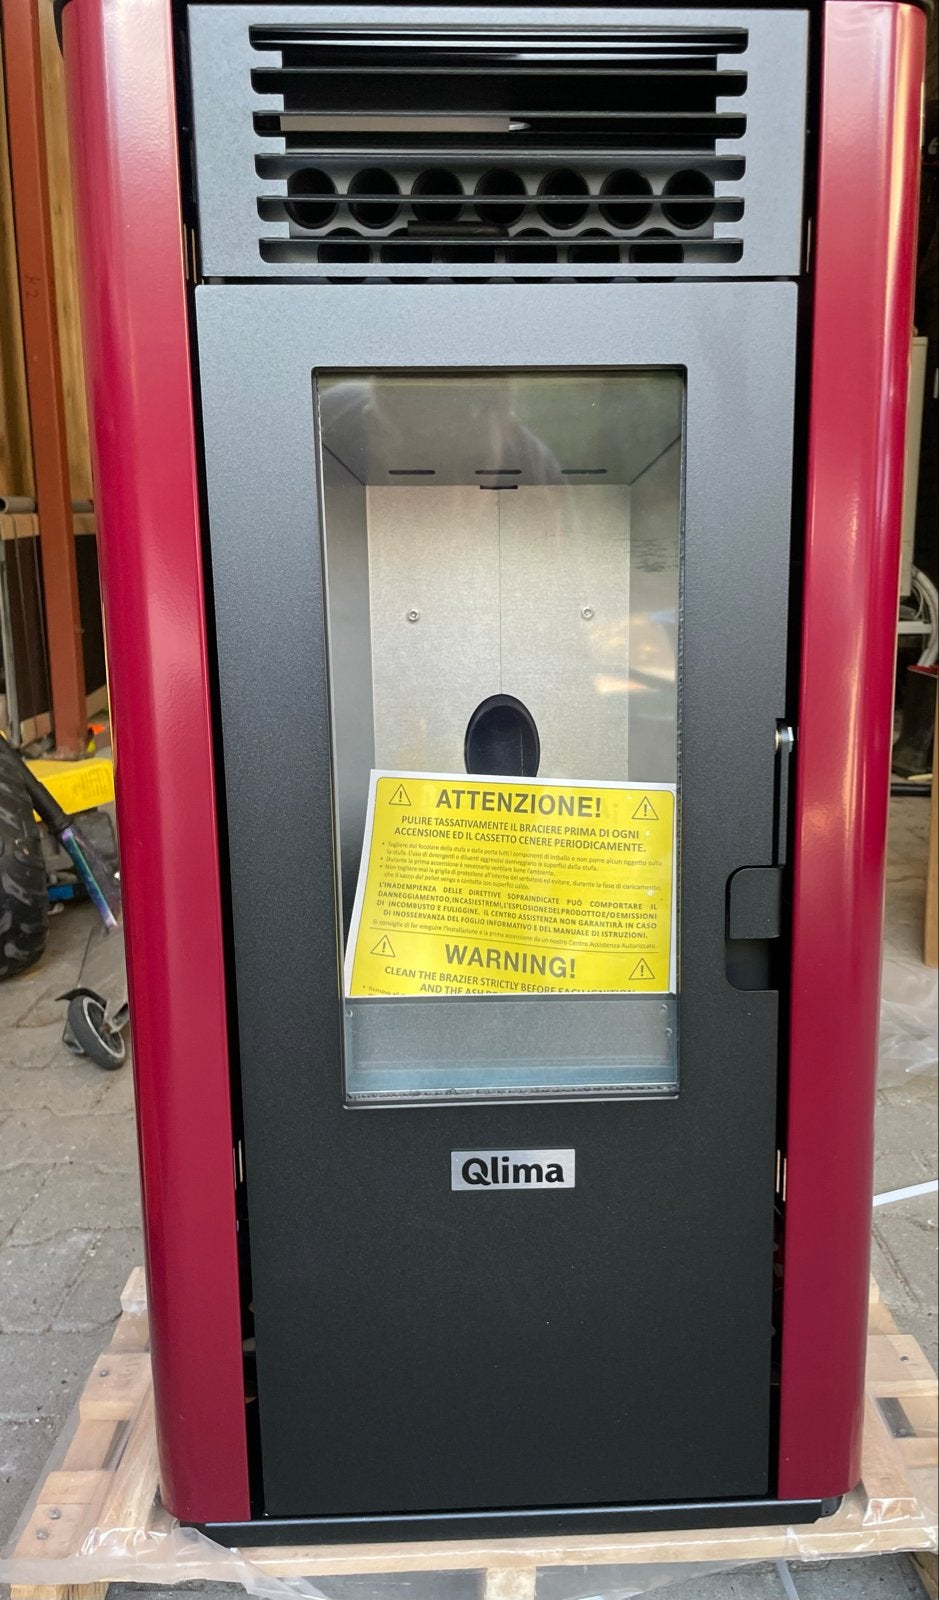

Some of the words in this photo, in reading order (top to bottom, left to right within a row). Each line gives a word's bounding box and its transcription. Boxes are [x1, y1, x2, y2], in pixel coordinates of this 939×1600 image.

[436, 788, 602, 818] ATTENZIONE!
[394, 827, 450, 839] ACCENSIONE
[452, 830, 464, 840] ED
[465, 831, 473, 841] IL
[474, 832, 517, 844] CASSETTO
[518, 835, 552, 847] CENERE
[554, 838, 646, 852] PERIODICAMENTE.
[401, 815, 432, 826] PULIRE
[434, 817, 508, 831] TASSATIVAMENTE
[510, 823, 518, 832] IL
[520, 823, 562, 835] BRACIERE
[564, 826, 597, 838] PRIMA
[599, 829, 610, 838] DI
[611, 829, 640, 840] OGNI
[379, 881, 437, 892] L'INADEMPIENZA
[443, 886, 463, 895] DELLE
[468, 889, 501, 899] DIRETTIVE
[507, 893, 560, 905] SOPRAINDICATE
[566, 898, 583, 907] PUÒ
[589, 900, 643, 910] COMPORTARE
[388, 901, 435, 911] INCOMBUSTO
[490, 910, 517, 919] CENTRO
[517, 913, 558, 924] ASSISTENZA
[578, 919, 623, 928] GARANTIRÀ
[393, 910, 445, 920] INOSSERVANZA
[460, 917, 485, 925] FOGLIO
[486, 919, 532, 931] INFORMATIVO
[539, 925, 551, 933] DEL
[553, 927, 590, 936] MANUALE
[601, 931, 648, 939] ISTRUZIONI.
[445, 943, 576, 979] WARNING!
[384, 965, 416, 978] CLEAN
[418, 970, 437, 981] THE
[439, 972, 479, 985] BRAZIER
[480, 977, 519, 991] STRICTLY
[520, 982, 557, 993] BEFORE
[420, 983, 443, 994] AND
[444, 985, 463, 994] THE
[462, 1156, 565, 1186] Qlima
